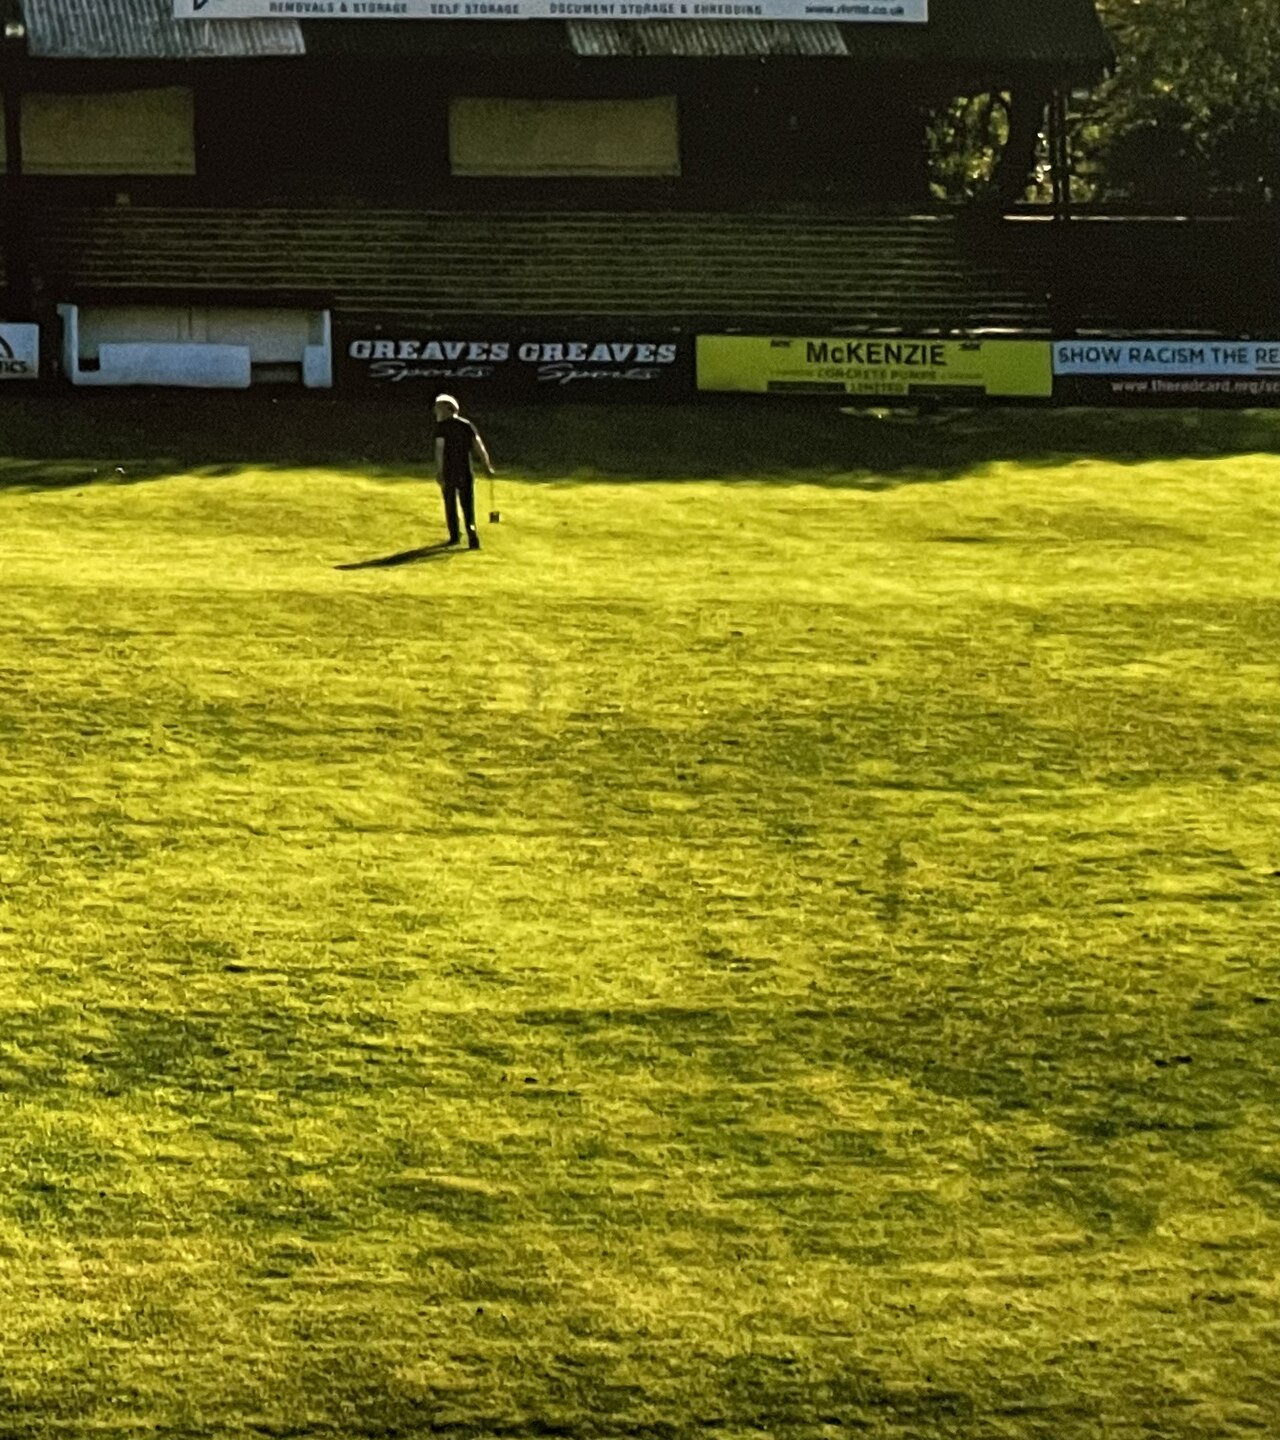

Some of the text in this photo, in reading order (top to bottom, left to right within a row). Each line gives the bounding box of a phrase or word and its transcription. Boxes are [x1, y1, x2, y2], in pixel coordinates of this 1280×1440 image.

[269, 2, 334, 13] REMOVALS
[353, 2, 407, 13] STORAGE
[465, 3, 520, 14] STORAGE
[550, 3, 615, 15] DOCUMENT
[621, 3, 675, 15] STORAGE
[349, 340, 510, 361] GREAVES
[517, 342, 677, 363] GREAVES
[806, 341, 947, 366] McKENZIE
[1059, 347, 1280, 364] SHOW RACISM THE RE
